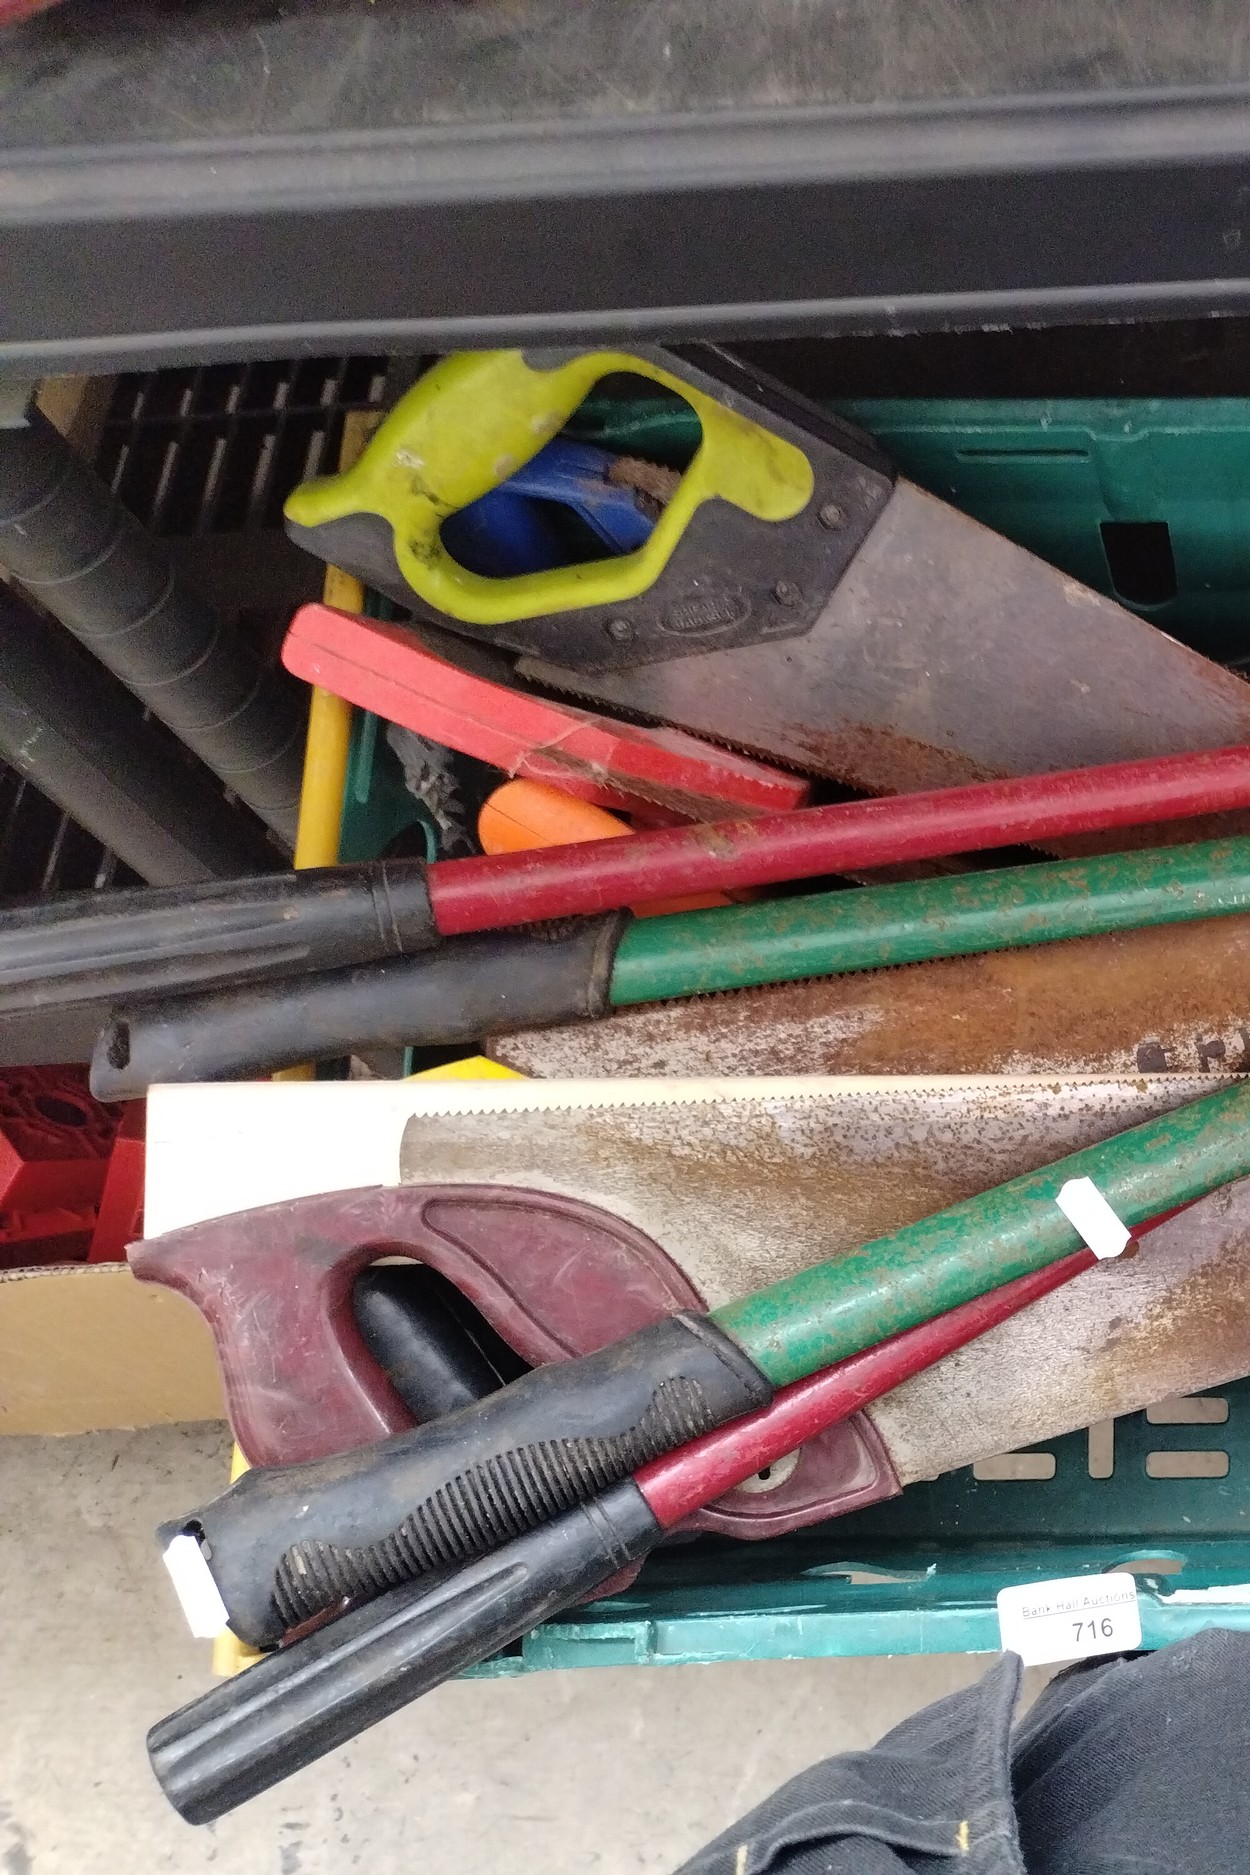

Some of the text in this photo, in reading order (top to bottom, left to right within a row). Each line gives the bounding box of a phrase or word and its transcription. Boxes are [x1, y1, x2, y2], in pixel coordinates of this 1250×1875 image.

[1022, 1591, 1136, 1617] Bank Hall Auctions
[1072, 1618, 1113, 1642] 716
